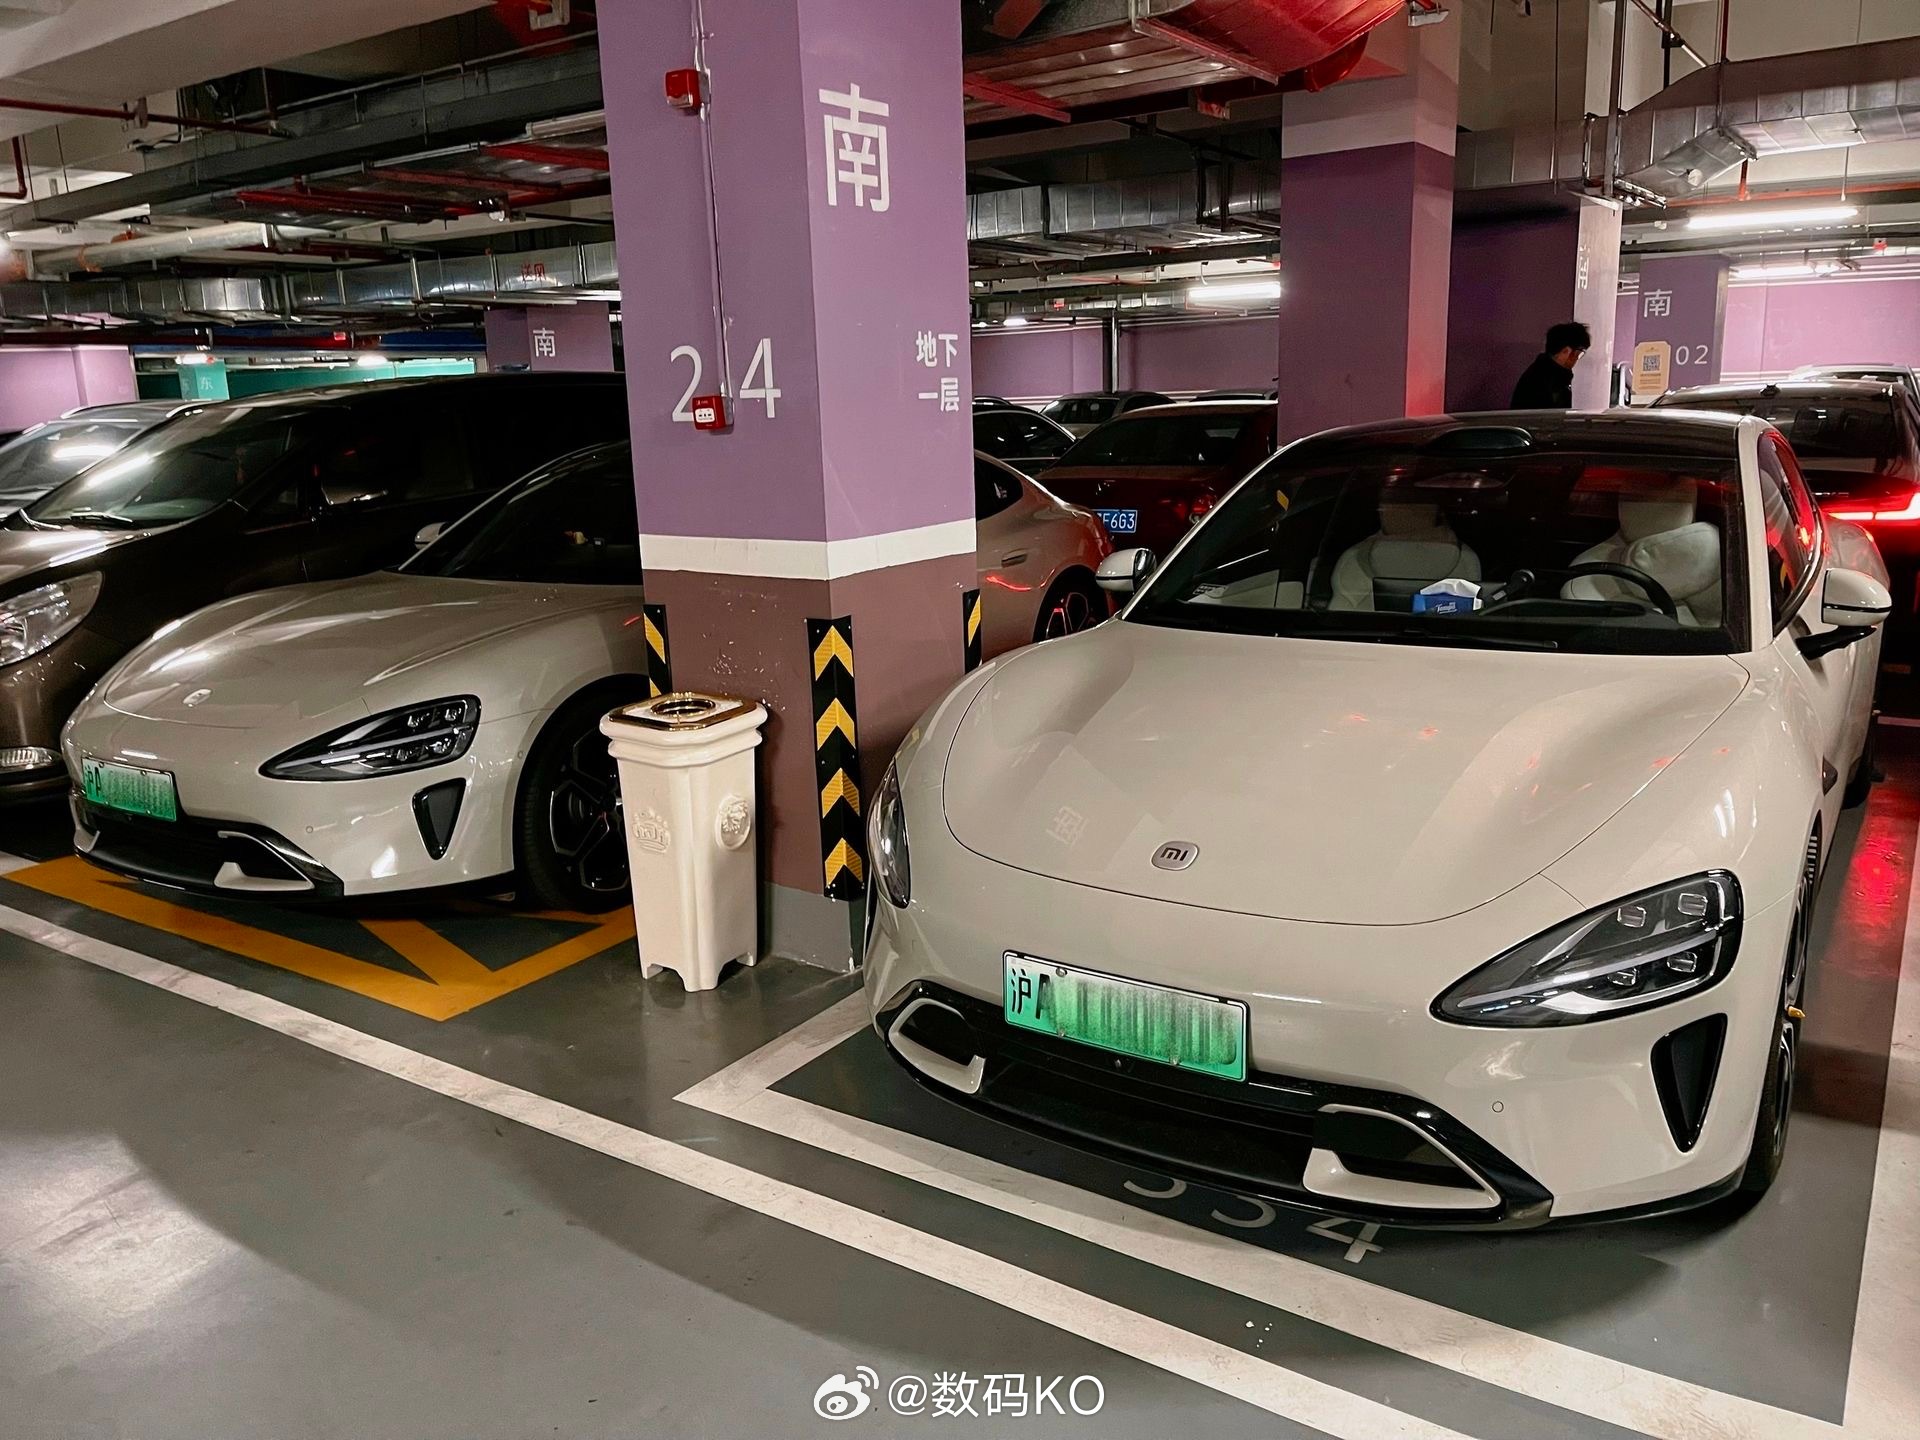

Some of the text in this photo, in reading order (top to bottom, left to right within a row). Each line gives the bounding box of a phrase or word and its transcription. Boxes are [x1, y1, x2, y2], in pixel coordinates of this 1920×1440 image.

[819, 83, 889, 212] 南
[1643, 289, 1673, 318] 南
[533, 327, 556, 357] 南
[916, 330, 959, 368] 地下
[1675, 344, 1709, 366] 02
[670, 338, 781, 422] 24
[918, 377, 960, 412] 一层
